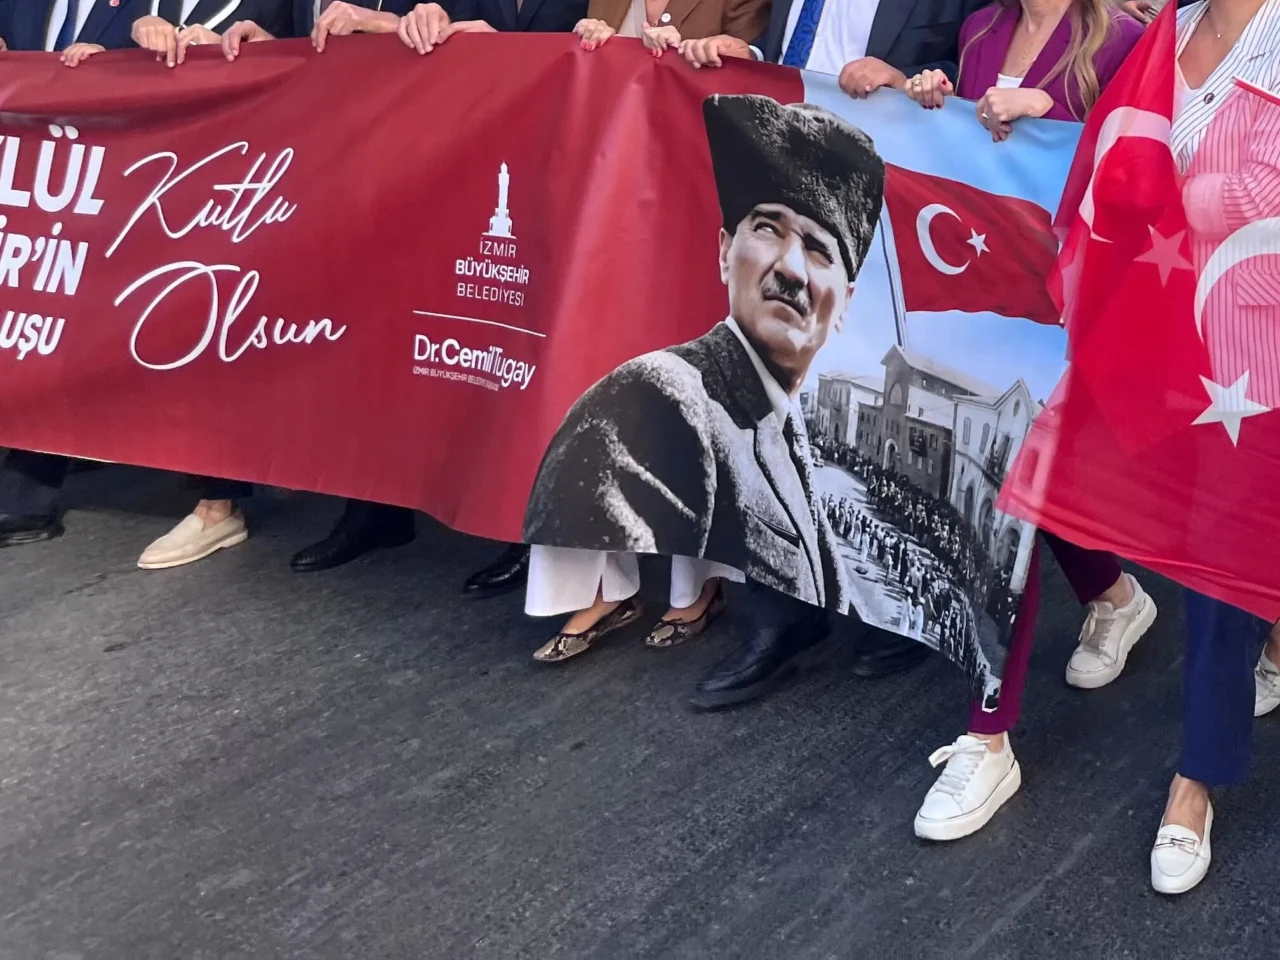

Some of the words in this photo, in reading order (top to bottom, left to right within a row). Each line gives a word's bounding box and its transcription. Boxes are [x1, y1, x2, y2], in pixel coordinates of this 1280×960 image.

[0, 123, 106, 215] LÜL
[105, 141, 298, 259] Kutlu
[455, 256, 530, 285] BÜYÜKŞEHİR
[480, 237, 517, 258] İZMİR
[114, 260, 347, 370] Olsun
[413, 333, 440, 363] Dr.
